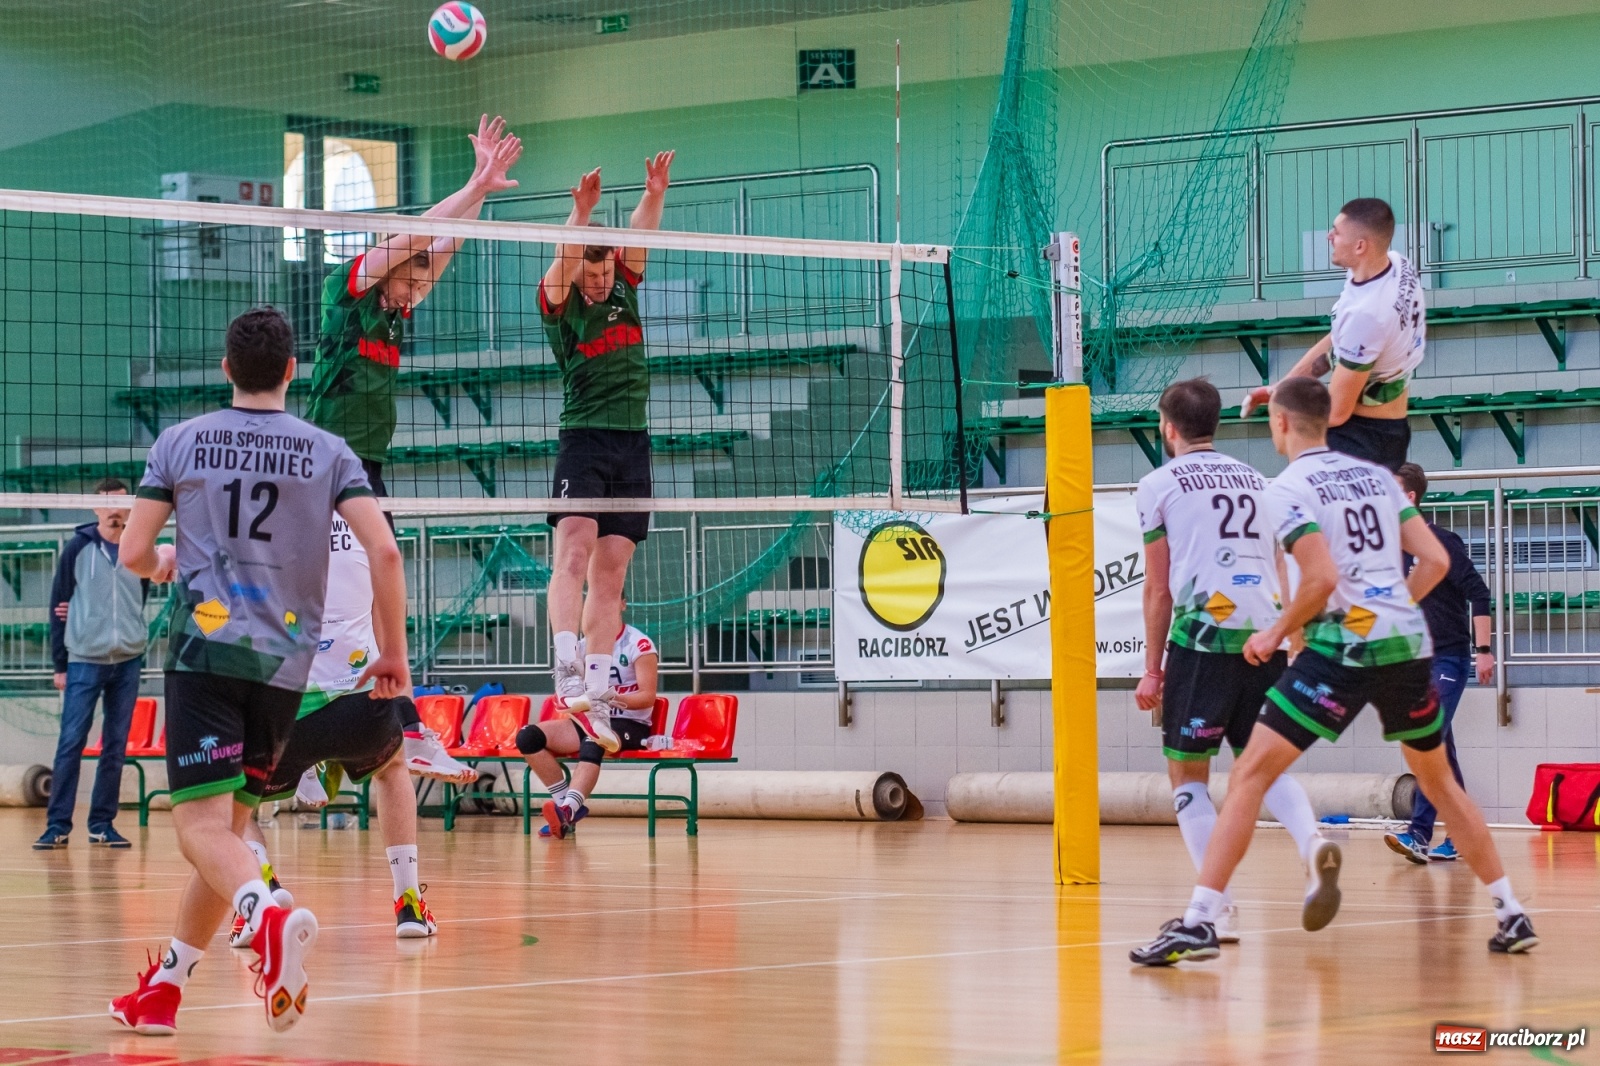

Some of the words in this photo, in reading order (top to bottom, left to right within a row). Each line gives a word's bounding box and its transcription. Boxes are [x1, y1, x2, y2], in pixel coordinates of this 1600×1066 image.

[809, 63, 845, 84] A
[195, 430, 233, 446] KLUB
[236, 431, 314, 456] SPORTOWY
[194, 447, 314, 479] RUDZINIEC
[1170, 463, 1203, 478] KLUB
[560, 478, 569, 499] 2
[223, 478, 279, 542] 12
[1211, 493, 1260, 540] 22
[1344, 503, 1385, 555] 99
[964, 598, 1027, 648] JEST
[1032, 589, 1051, 618] W
[1093, 551, 1145, 597] ORZ
[857, 632, 949, 658] RACIBÓRZ
[177, 751, 206, 768] MIAMI
[211, 742, 244, 760] BURGE
